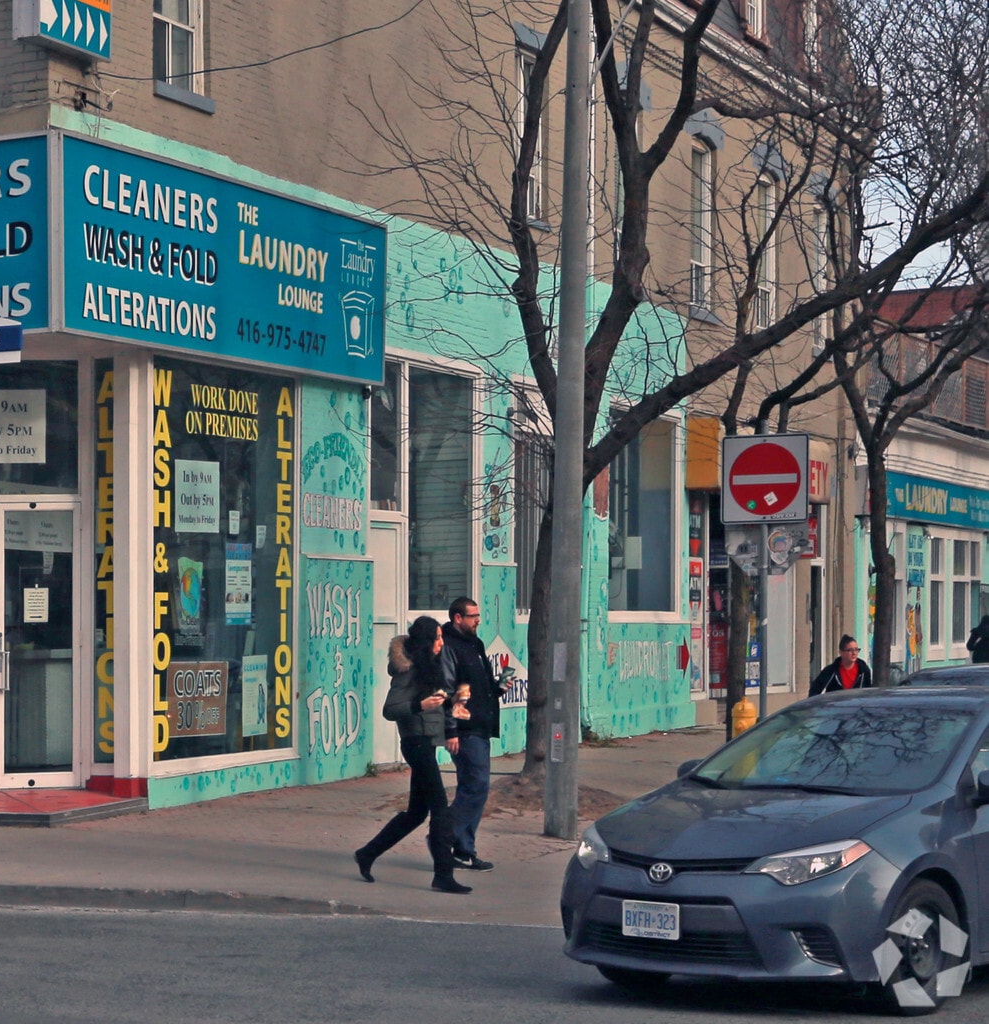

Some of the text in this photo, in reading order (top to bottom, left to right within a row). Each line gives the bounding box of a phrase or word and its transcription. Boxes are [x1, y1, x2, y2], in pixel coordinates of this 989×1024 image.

[82, 163, 219, 235] CLEANERS
[236, 201, 259, 227] THE
[83, 221, 218, 286] WASH & FOLD
[238, 229, 329, 284] LAUNDRY
[341, 244, 376, 282] Laundry
[82, 282, 217, 342] ALTERATIONS
[277, 283, 323, 314] LOUNGE
[236, 317, 327, 357] 416-975-4747
[1, 400, 28, 413] 9AM
[191, 383, 259, 415] WORK DONE
[7, 423, 32, 436] 5PM
[185, 410, 259, 442] ON PREMISES
[6, 445, 37, 457] Friday
[153, 369, 172, 528] WASH
[302, 432, 366, 486] ECO-FRIENDLY
[183, 470, 190, 483] In
[191, 471, 199, 486] by
[180, 492, 192, 505] Out
[193, 493, 201, 509] by
[303, 492, 362, 531] CLEANERS
[906, 482, 948, 516] LAUNDRY
[178, 514, 196, 526] Monday
[202, 515, 216, 526] Friday
[153, 542, 170, 574] &
[274, 386, 294, 739] ALTERATIONS
[306, 580, 360, 648] WASH
[153, 591, 171, 753] FOLD
[618, 641, 674, 682] LAUNDROMAT
[174, 670, 221, 697] COATS
[206, 707, 220, 725] OFF
[306, 687, 360, 757] FOLD
